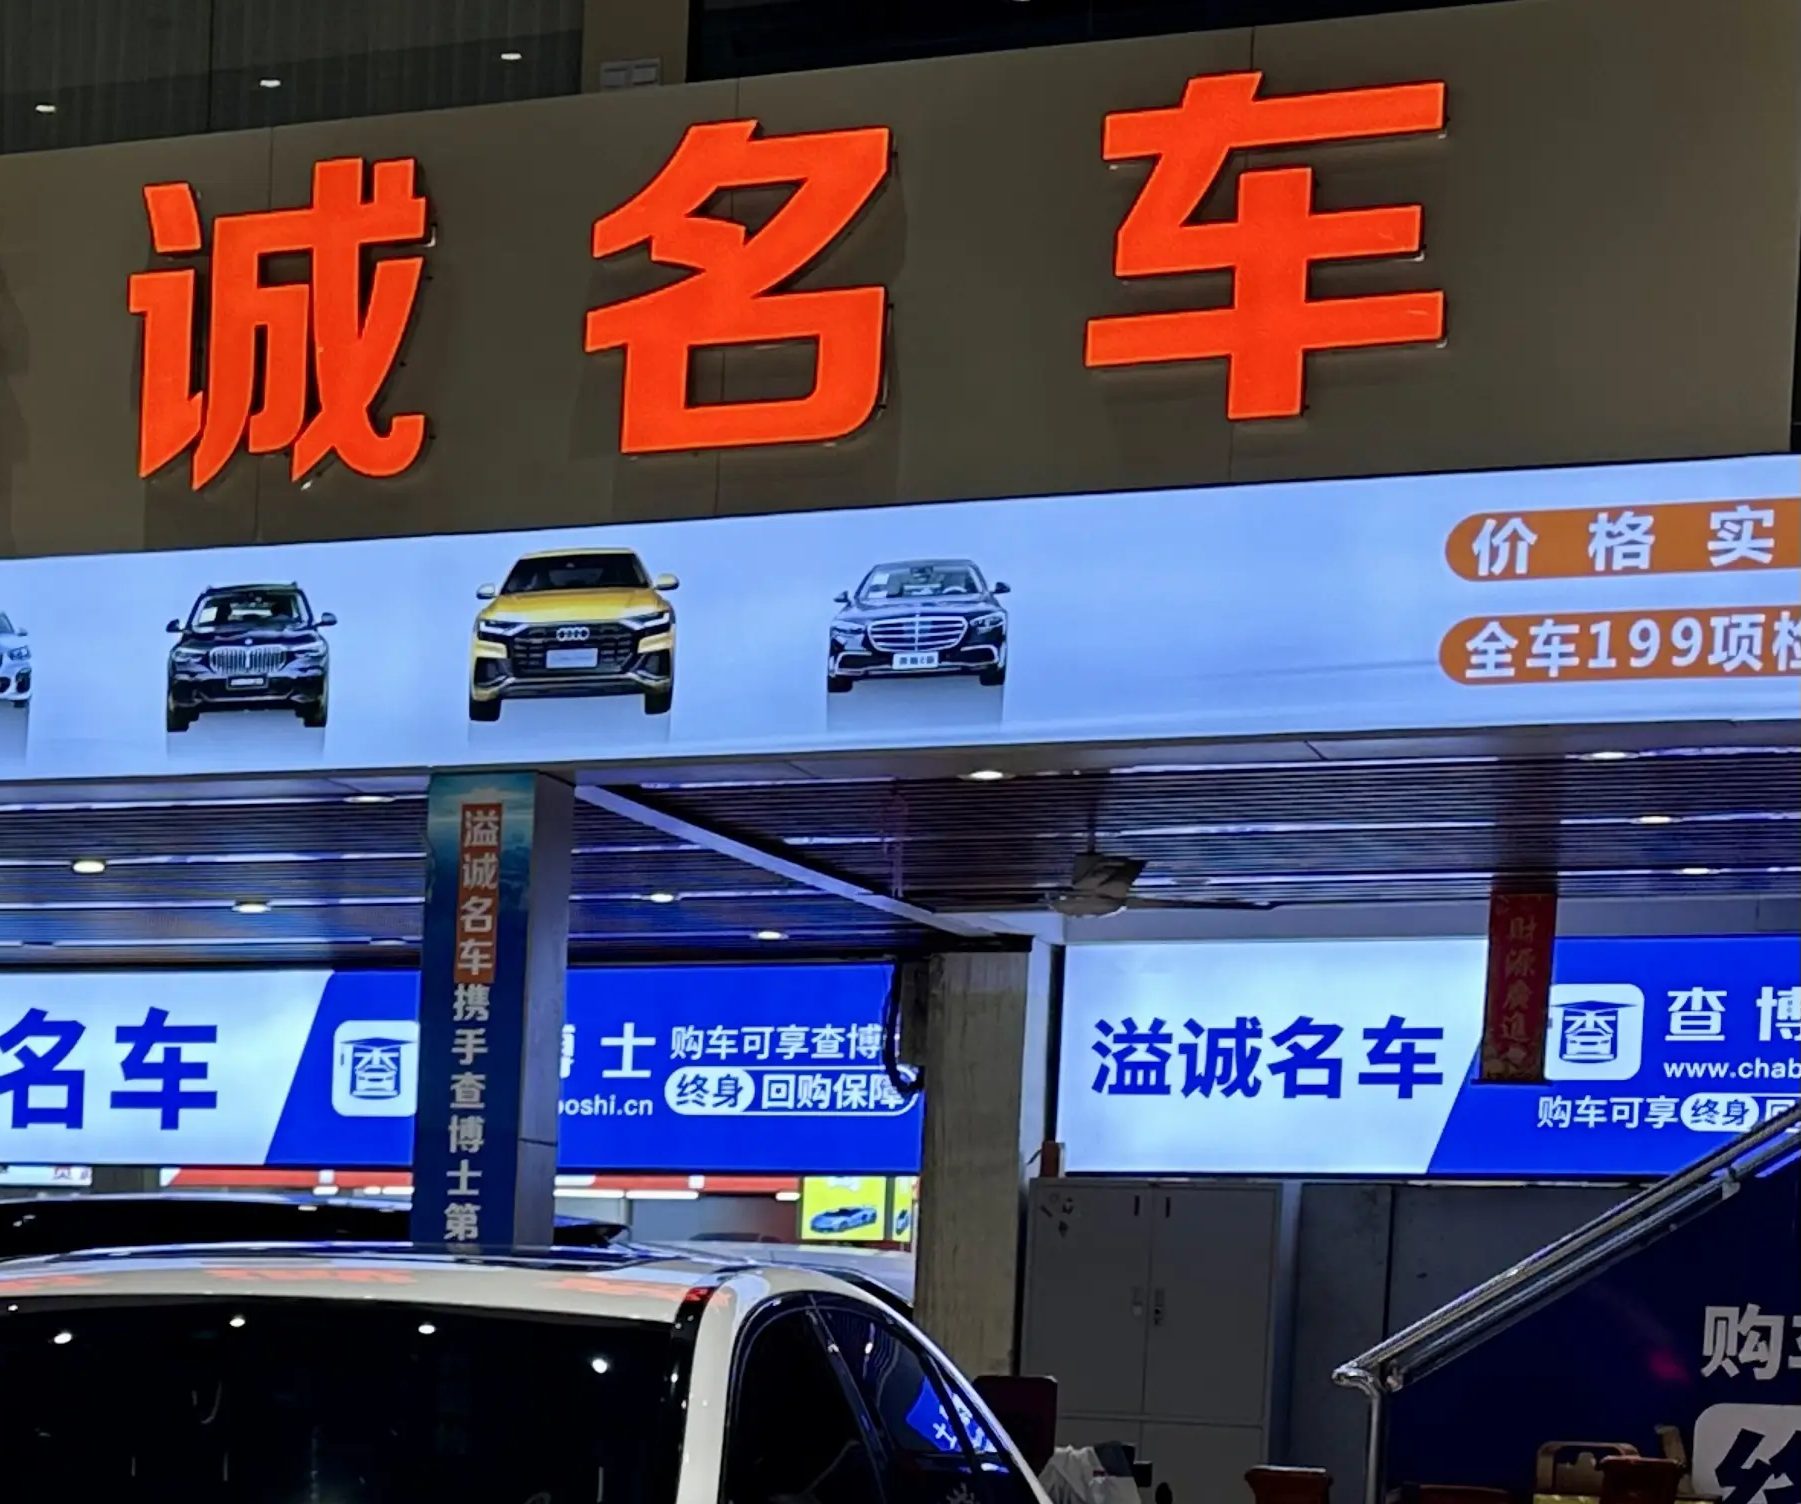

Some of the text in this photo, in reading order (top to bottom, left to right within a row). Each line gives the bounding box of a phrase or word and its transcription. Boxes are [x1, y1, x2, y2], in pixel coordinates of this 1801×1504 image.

[442, 809, 501, 1241] 溢诚名车携手查博士第
[1091, 1014, 1445, 1100] 溢诚名车
[1700, 1303, 1801, 1381] 购
